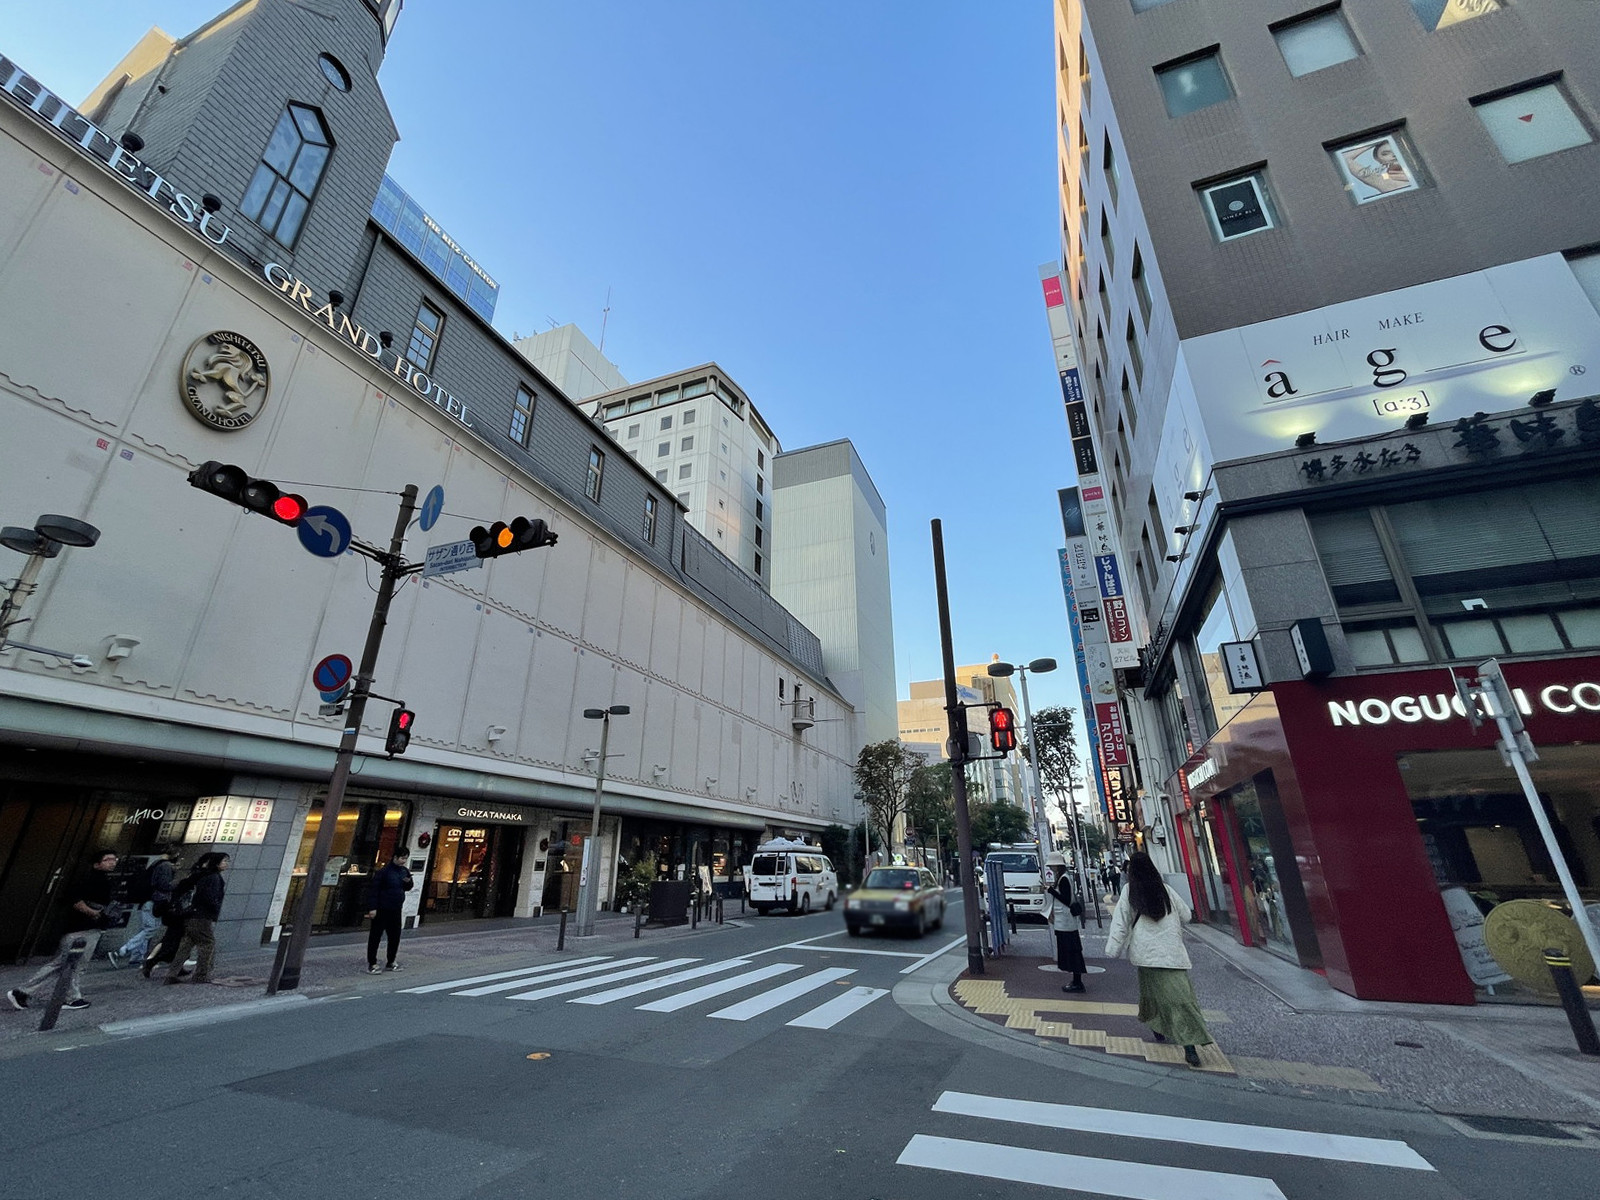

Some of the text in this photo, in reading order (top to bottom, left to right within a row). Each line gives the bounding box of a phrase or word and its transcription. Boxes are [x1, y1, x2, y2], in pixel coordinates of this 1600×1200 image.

[423, 213, 497, 289] THE RITZ-CARLTON
[264, 262, 383, 359] GRAND
[394, 354, 473, 428] HOTEL
[1312, 311, 1425, 346] HAIR MAKE
[213, 332, 267, 368] NISHITETSU
[187, 386, 252, 427] GRAND HOTEL
[1112, 599, 1128, 641] 野口コイン
[457, 808, 522, 821] GINZA TANAKA
